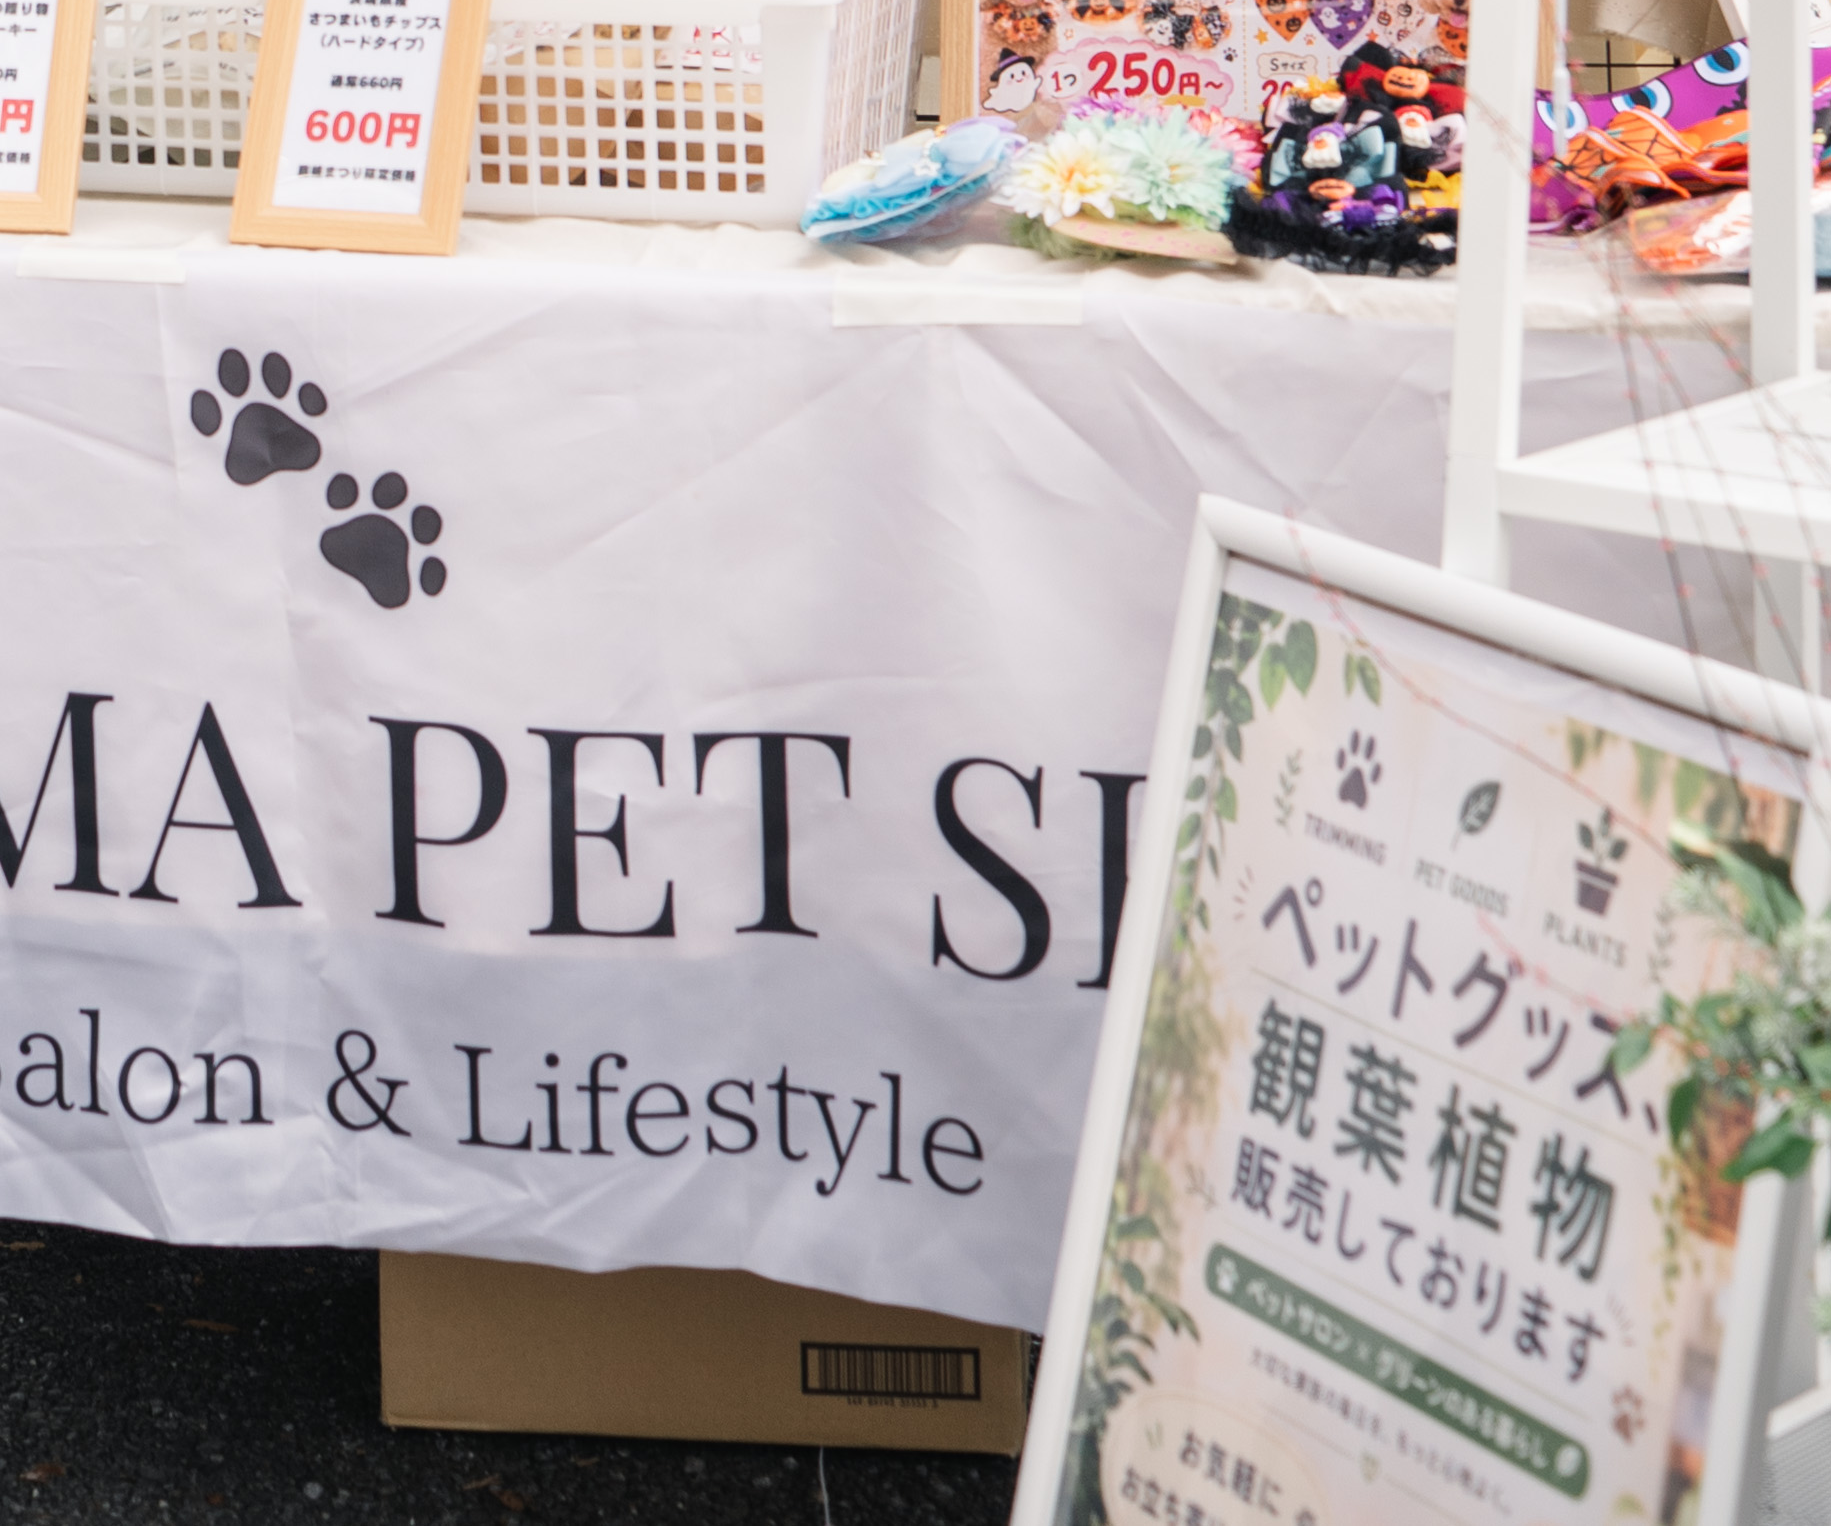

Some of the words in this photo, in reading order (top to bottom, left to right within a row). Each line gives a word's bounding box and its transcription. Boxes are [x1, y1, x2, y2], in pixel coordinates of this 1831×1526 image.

[305, 109, 422, 149] 600円
[369, 715, 851, 939] PET
[326, 1025, 412, 1140] &
[457, 1042, 986, 1199] Lifestyle
[1250, 998, 1617, 1284] 観葉植物
[1231, 1135, 1606, 1384] 販売しております
